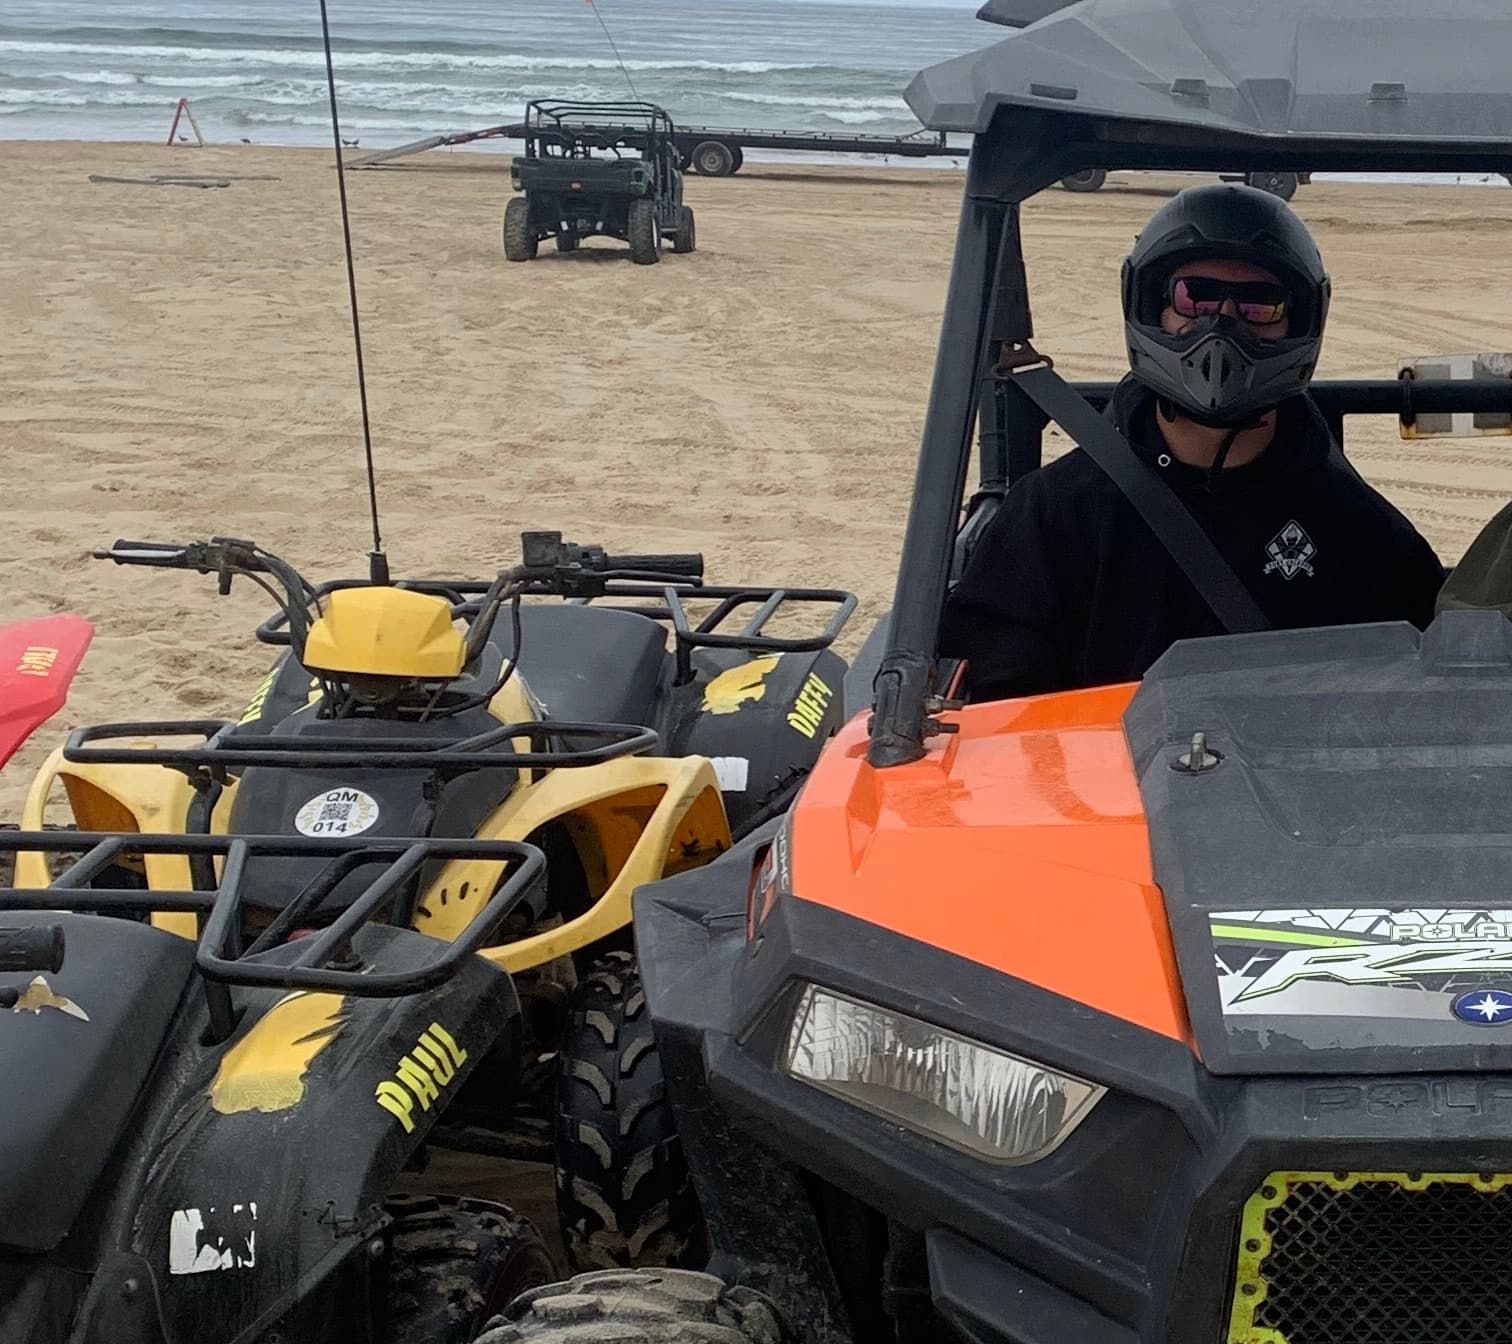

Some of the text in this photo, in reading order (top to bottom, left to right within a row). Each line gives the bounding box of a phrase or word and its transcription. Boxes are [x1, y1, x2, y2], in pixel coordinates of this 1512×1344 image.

[786, 671, 833, 739] DAFFY
[326, 791, 359, 802] QM
[312, 821, 348, 833] 014
[374, 1021, 468, 1134] PAUL
